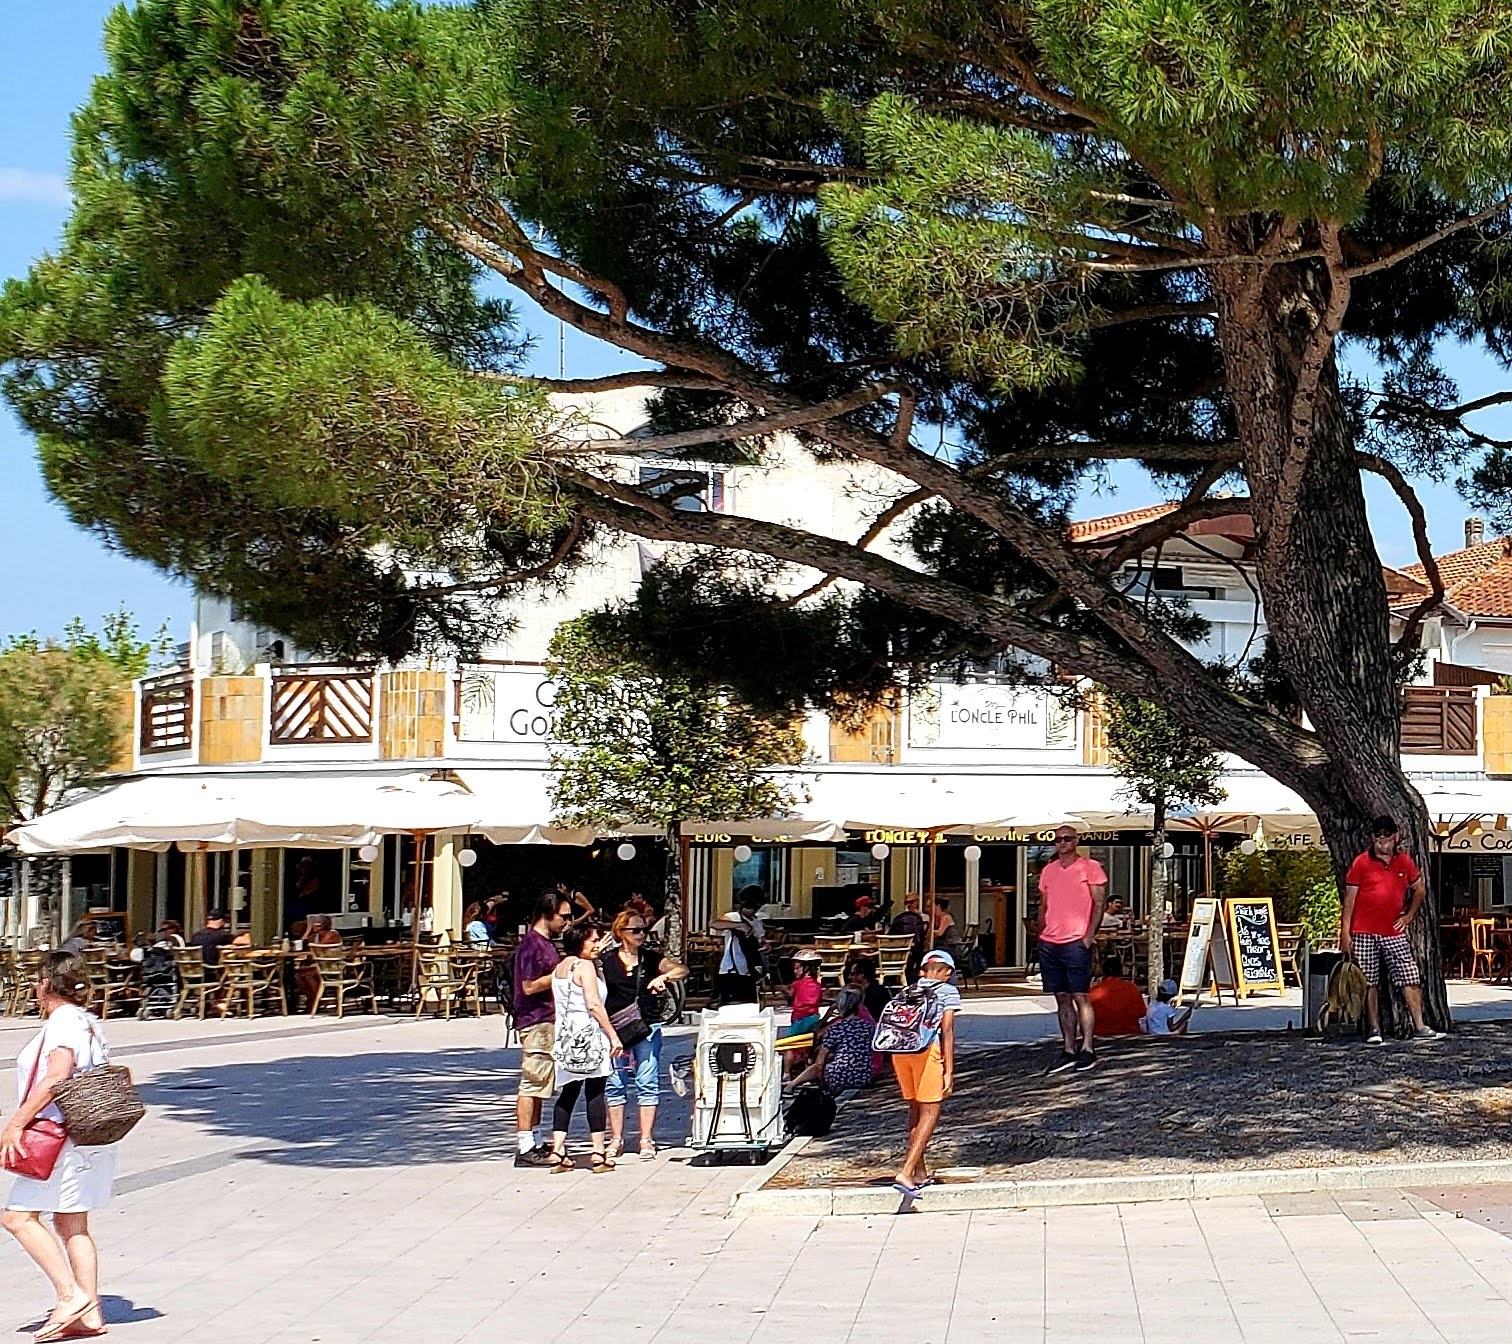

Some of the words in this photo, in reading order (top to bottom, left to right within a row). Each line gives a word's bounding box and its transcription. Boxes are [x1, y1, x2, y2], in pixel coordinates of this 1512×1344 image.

[951, 708, 1003, 724] L'ONCLE
[1007, 709, 1037, 725] PHIL
[974, 830, 1030, 842] CINE
[1036, 830, 1120, 842] GOANDE
[1448, 834, 1472, 850] La
